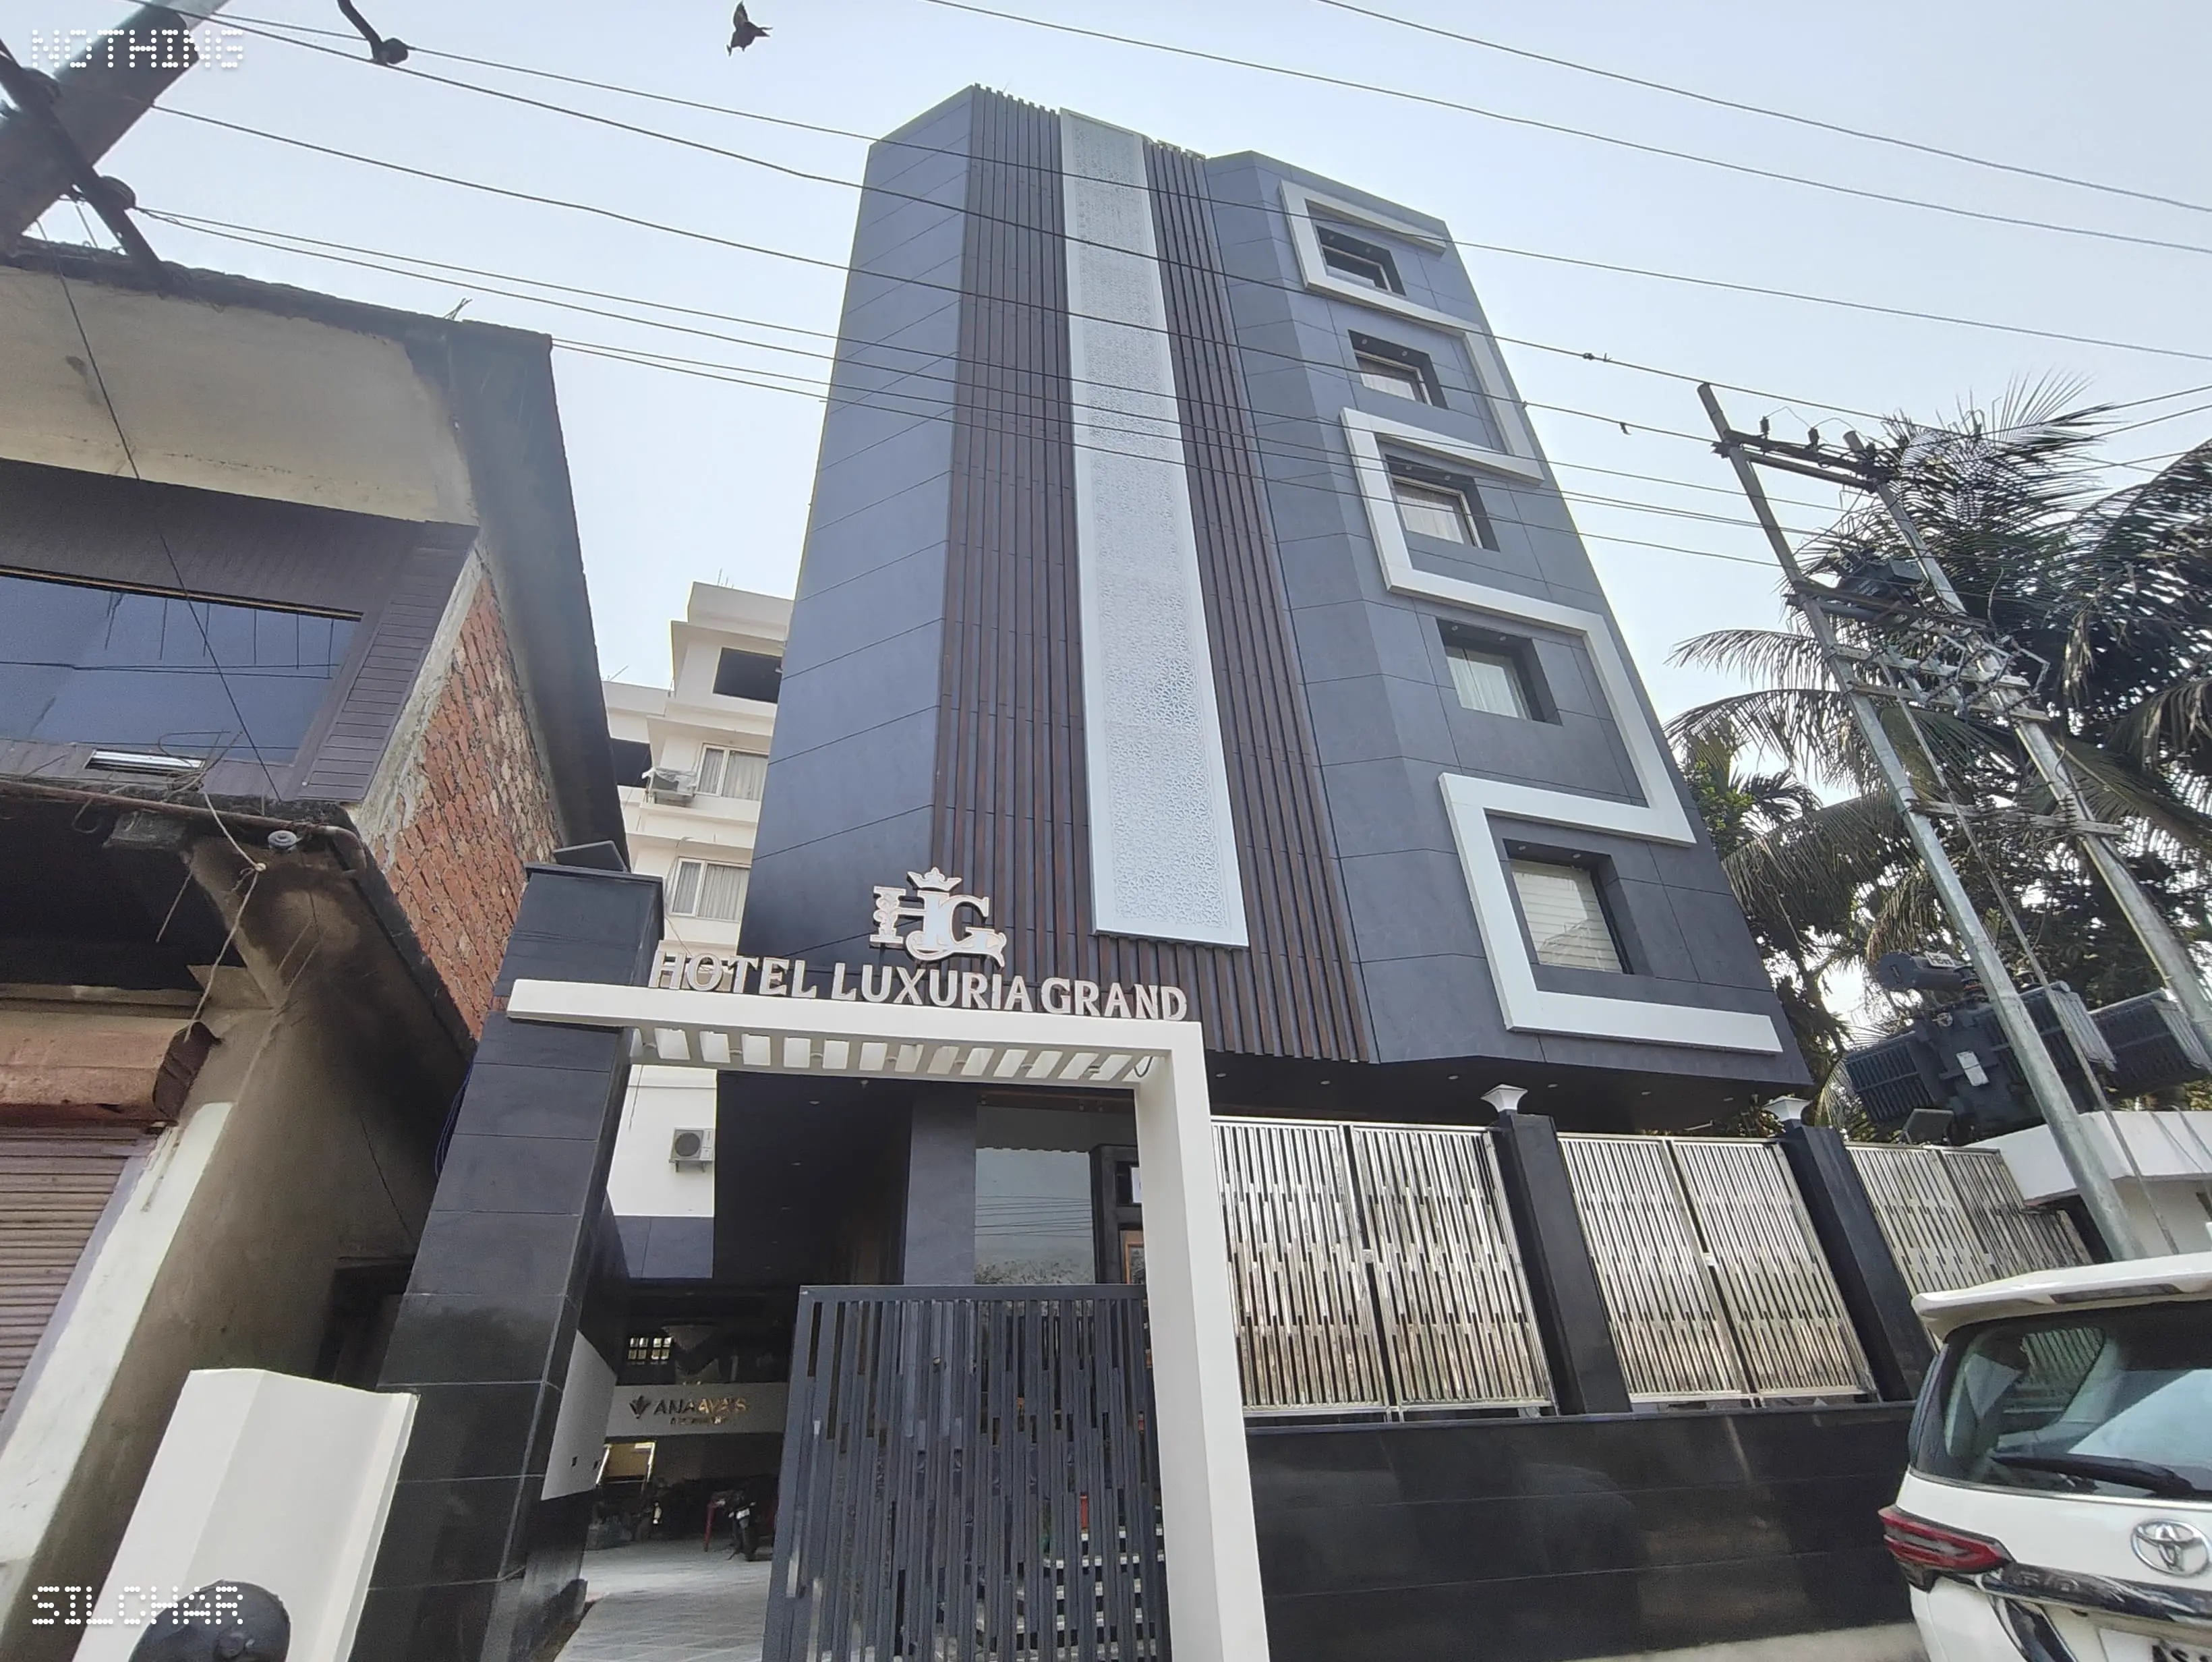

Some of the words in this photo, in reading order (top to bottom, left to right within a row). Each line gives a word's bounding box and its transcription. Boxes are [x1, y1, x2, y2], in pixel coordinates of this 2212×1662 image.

[648, 950, 817, 998] HOTEL
[831, 963, 1032, 1012] LUXURIA
[1041, 977, 1187, 1021] GRAND
